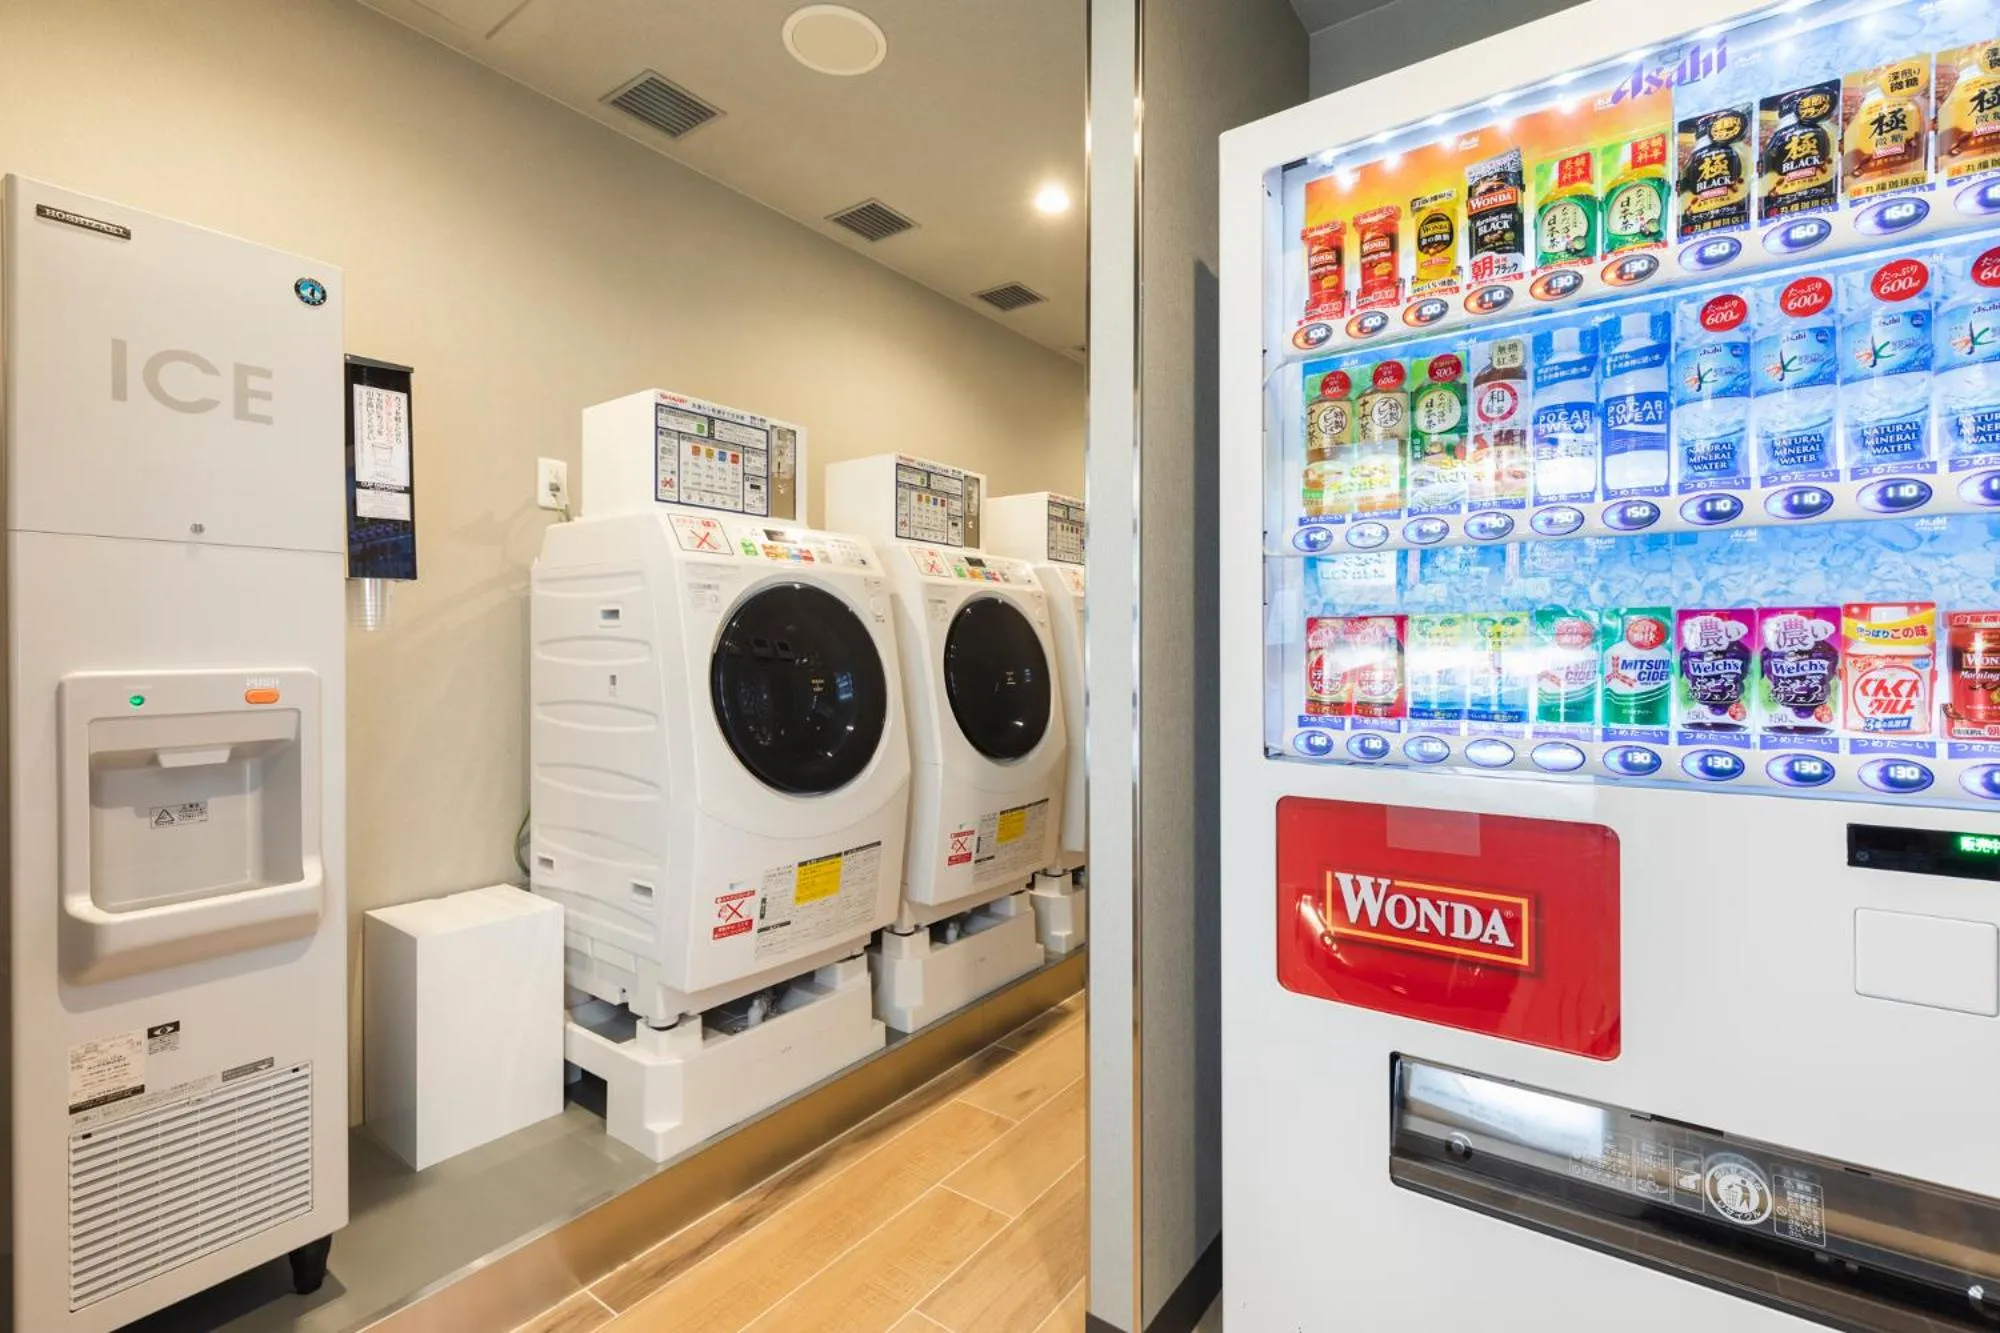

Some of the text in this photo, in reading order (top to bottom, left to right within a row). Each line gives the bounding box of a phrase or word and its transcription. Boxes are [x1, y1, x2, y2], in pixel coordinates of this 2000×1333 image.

[1611, 34, 1728, 105] Asahi
[1869, 107, 1908, 139] 極
[1784, 132, 1818, 162] 極
[1697, 153, 1731, 181] 極
[1782, 156, 1820, 172] BLACK
[1696, 177, 1732, 192] BLACK
[1470, 192, 1514, 210] WONDA
[1478, 220, 1510, 235] BLACK
[1471, 256, 1494, 280] 朝
[1625, 260, 1648, 273] 130
[1551, 276, 1573, 289] 130
[1484, 289, 1504, 302] 110
[1422, 303, 1440, 315] 100
[1364, 316, 1381, 327] 100
[1310, 327, 1325, 338] 100
[110, 338, 274, 425] ICE
[1490, 389, 1505, 402] 和
[1608, 411, 1663, 427] SWEAT
[1864, 421, 1919, 438] NATURAL
[1773, 433, 1823, 449] NATURAL
[1865, 432, 1918, 448] MINERAL
[1687, 441, 1734, 456] NATURAL
[1773, 445, 1822, 459] MINERAL
[1870, 443, 1914, 456] WATER
[1688, 452, 1733, 466] MINERAL
[1778, 454, 1818, 467] WATER
[1692, 461, 1729, 473] WATER
[1886, 485, 1918, 498] 110
[1706, 499, 1732, 512] 110
[1792, 493, 1820, 506] 110
[1627, 506, 1650, 518] 150
[1775, 618, 1829, 649] 濃い
[1856, 624, 1928, 640] やっぱりこの味
[1690, 659, 1741, 675] Welch's
[1773, 659, 1827, 676] Welch's
[1773, 679, 1822, 694] ぶどう
[1627, 752, 1650, 764] 130
[1706, 756, 1733, 770] 130
[1793, 761, 1822, 775] 130
[1888, 766, 1920, 780] 130
[1334, 871, 1514, 948] WONDA
